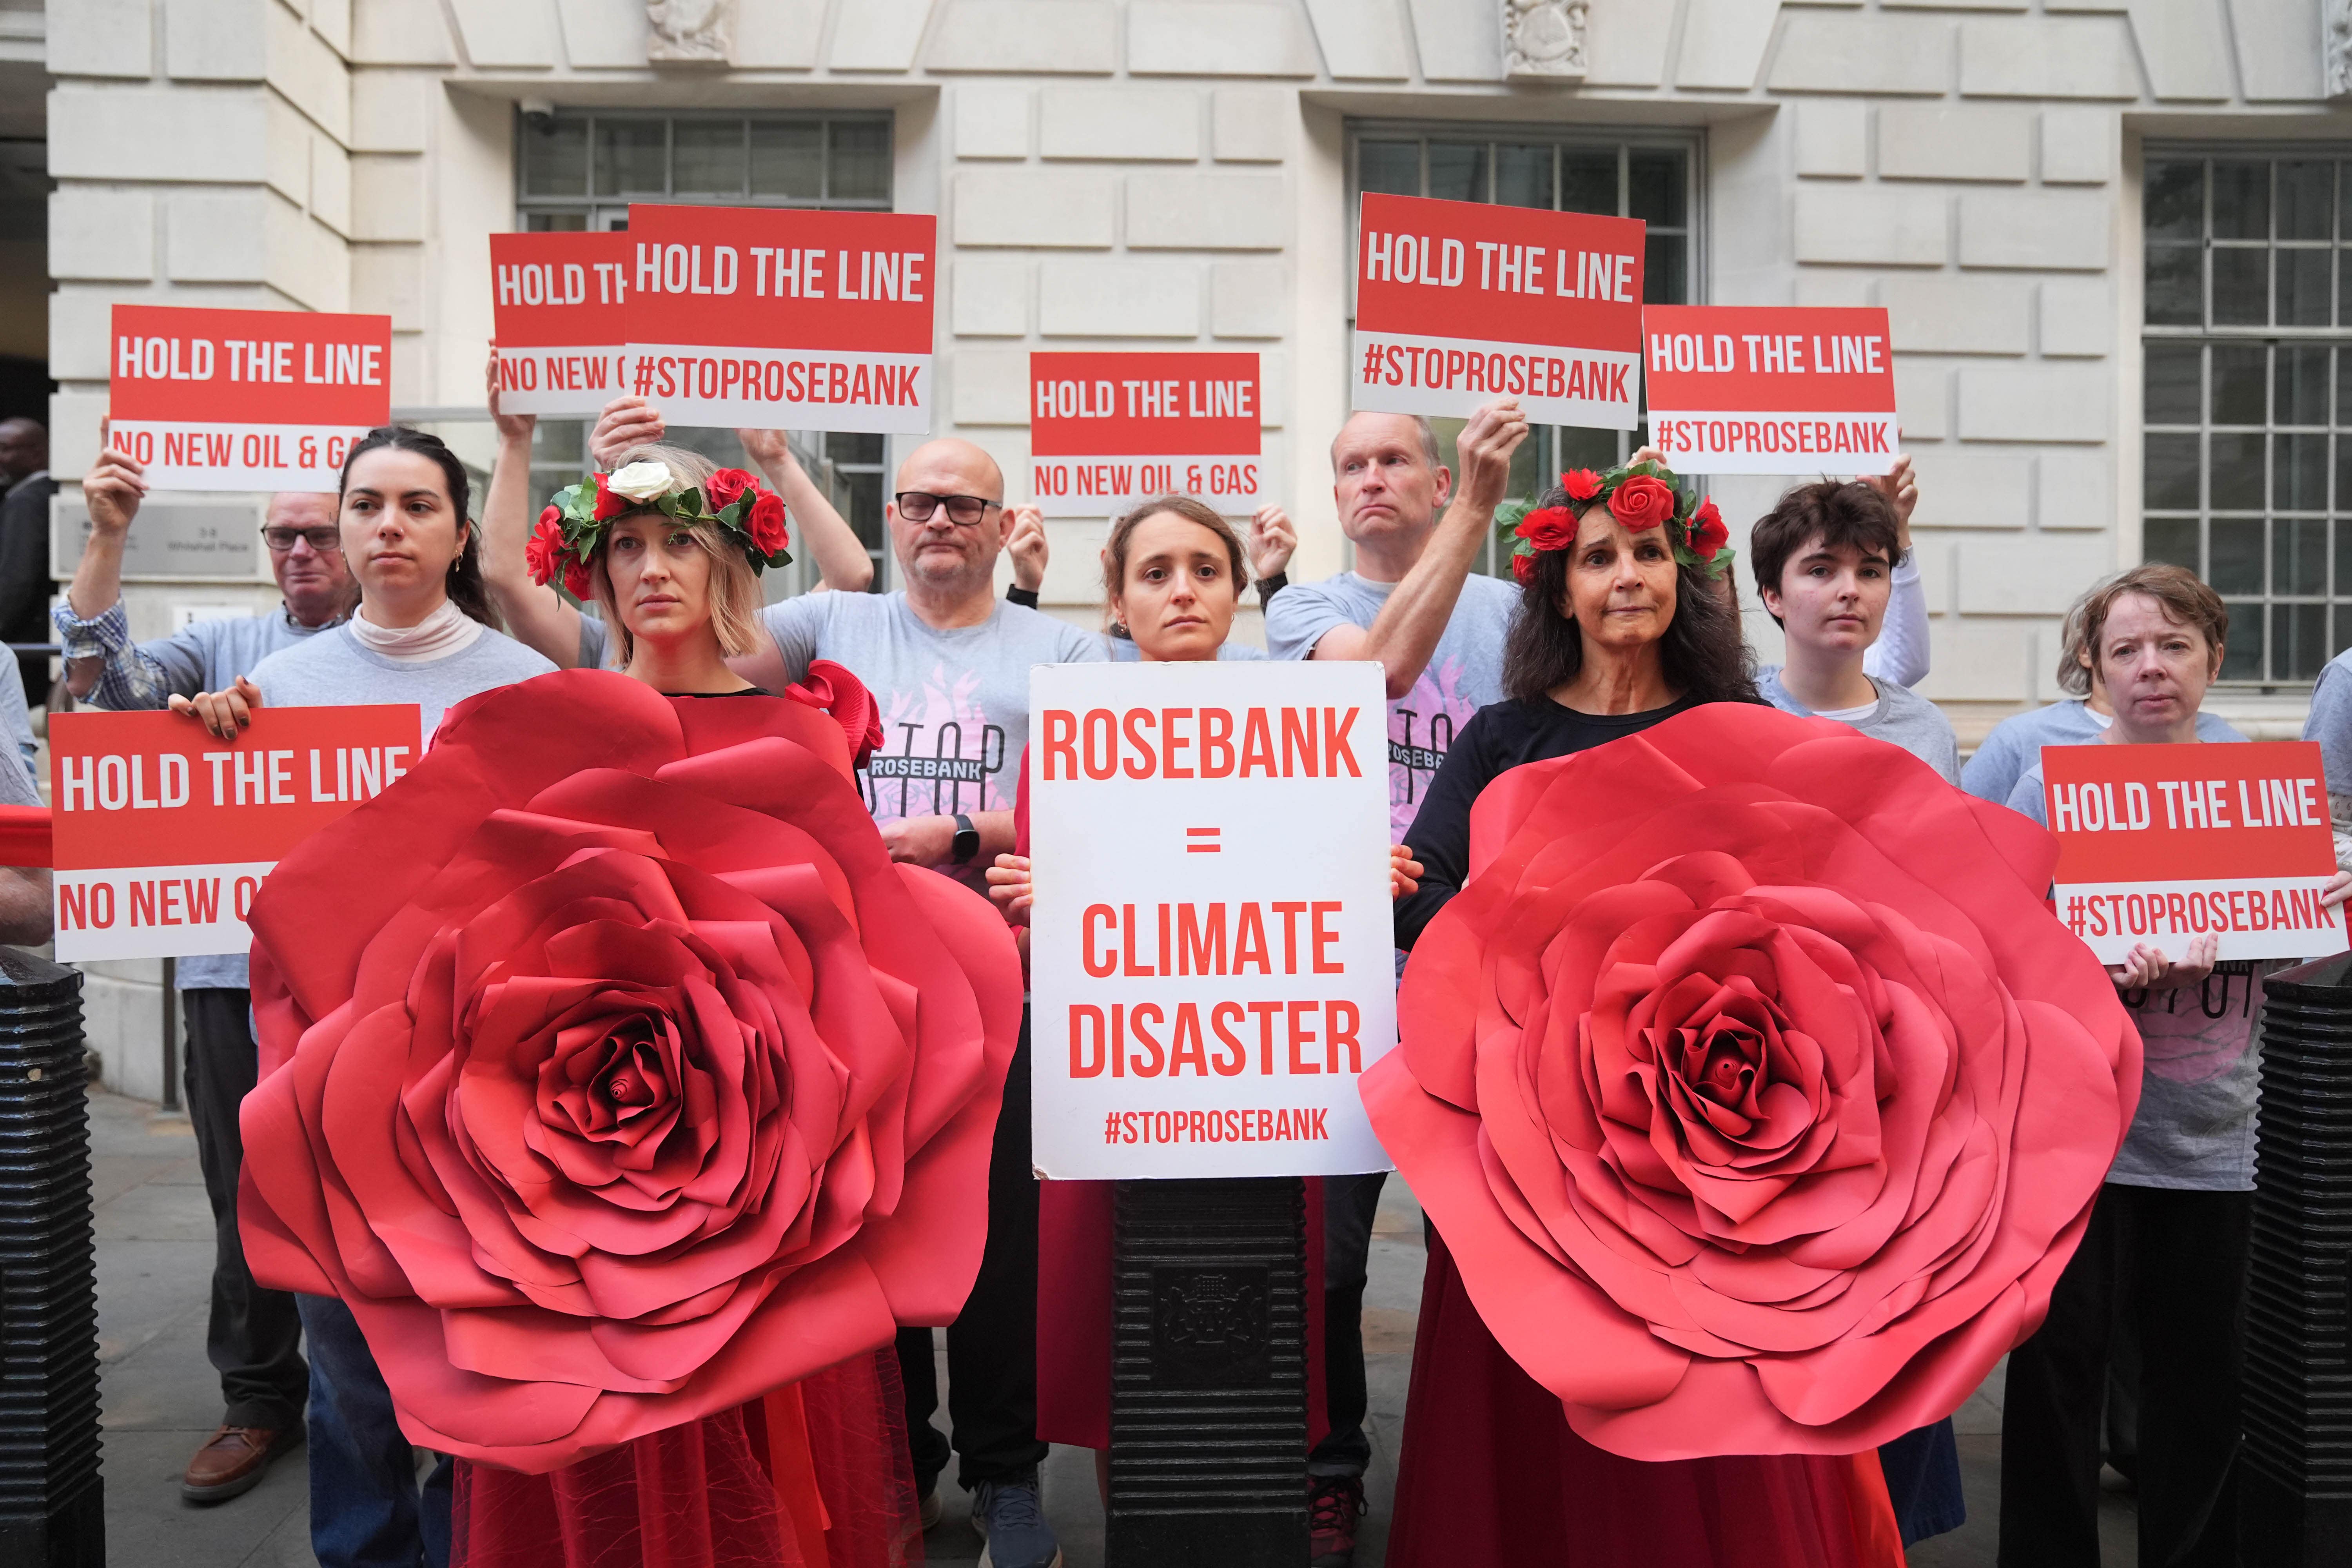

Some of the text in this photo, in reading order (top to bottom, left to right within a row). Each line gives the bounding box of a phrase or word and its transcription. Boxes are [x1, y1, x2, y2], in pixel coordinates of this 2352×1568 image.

[499, 264, 627, 305] HOLD TH
[637, 243, 924, 301] HOLD THE LINE
[1368, 232, 1634, 302] HOLD THE LINE
[119, 336, 382, 385] HOLD THE LINE
[500, 358, 537, 391] NO
[547, 357, 607, 390] NEW
[1363, 343, 1630, 403] #STOPROSEBANK
[1651, 334, 1884, 373] HOLD THE LINE
[634, 356, 920, 407] #STOPROSEBANK
[1037, 381, 1253, 417] HOLD THE LINE
[114, 431, 153, 465] NO
[165, 433, 232, 466] NEW
[244, 434, 288, 467] OIL
[299, 436, 317, 468] &
[1657, 421, 1889, 453] #STOPROSEBANK
[1036, 465, 1257, 495] NO NEW OIL & GAS
[1044, 707, 1362, 780] ROSEBANK
[63, 754, 189, 811] HOLD
[203, 750, 295, 806] THE
[871, 759, 982, 780] ROSEBANK
[2053, 779, 2321, 832] HOLD THE LINE
[60, 883, 114, 930] NO
[130, 878, 220, 926] NEW
[2067, 889, 2335, 937] #STOPROSEBANK
[1083, 901, 1344, 978] CLIMATE
[1069, 1000, 1363, 1078] DISASTER
[1105, 1108, 1328, 1143] #STOPROSEBANK
